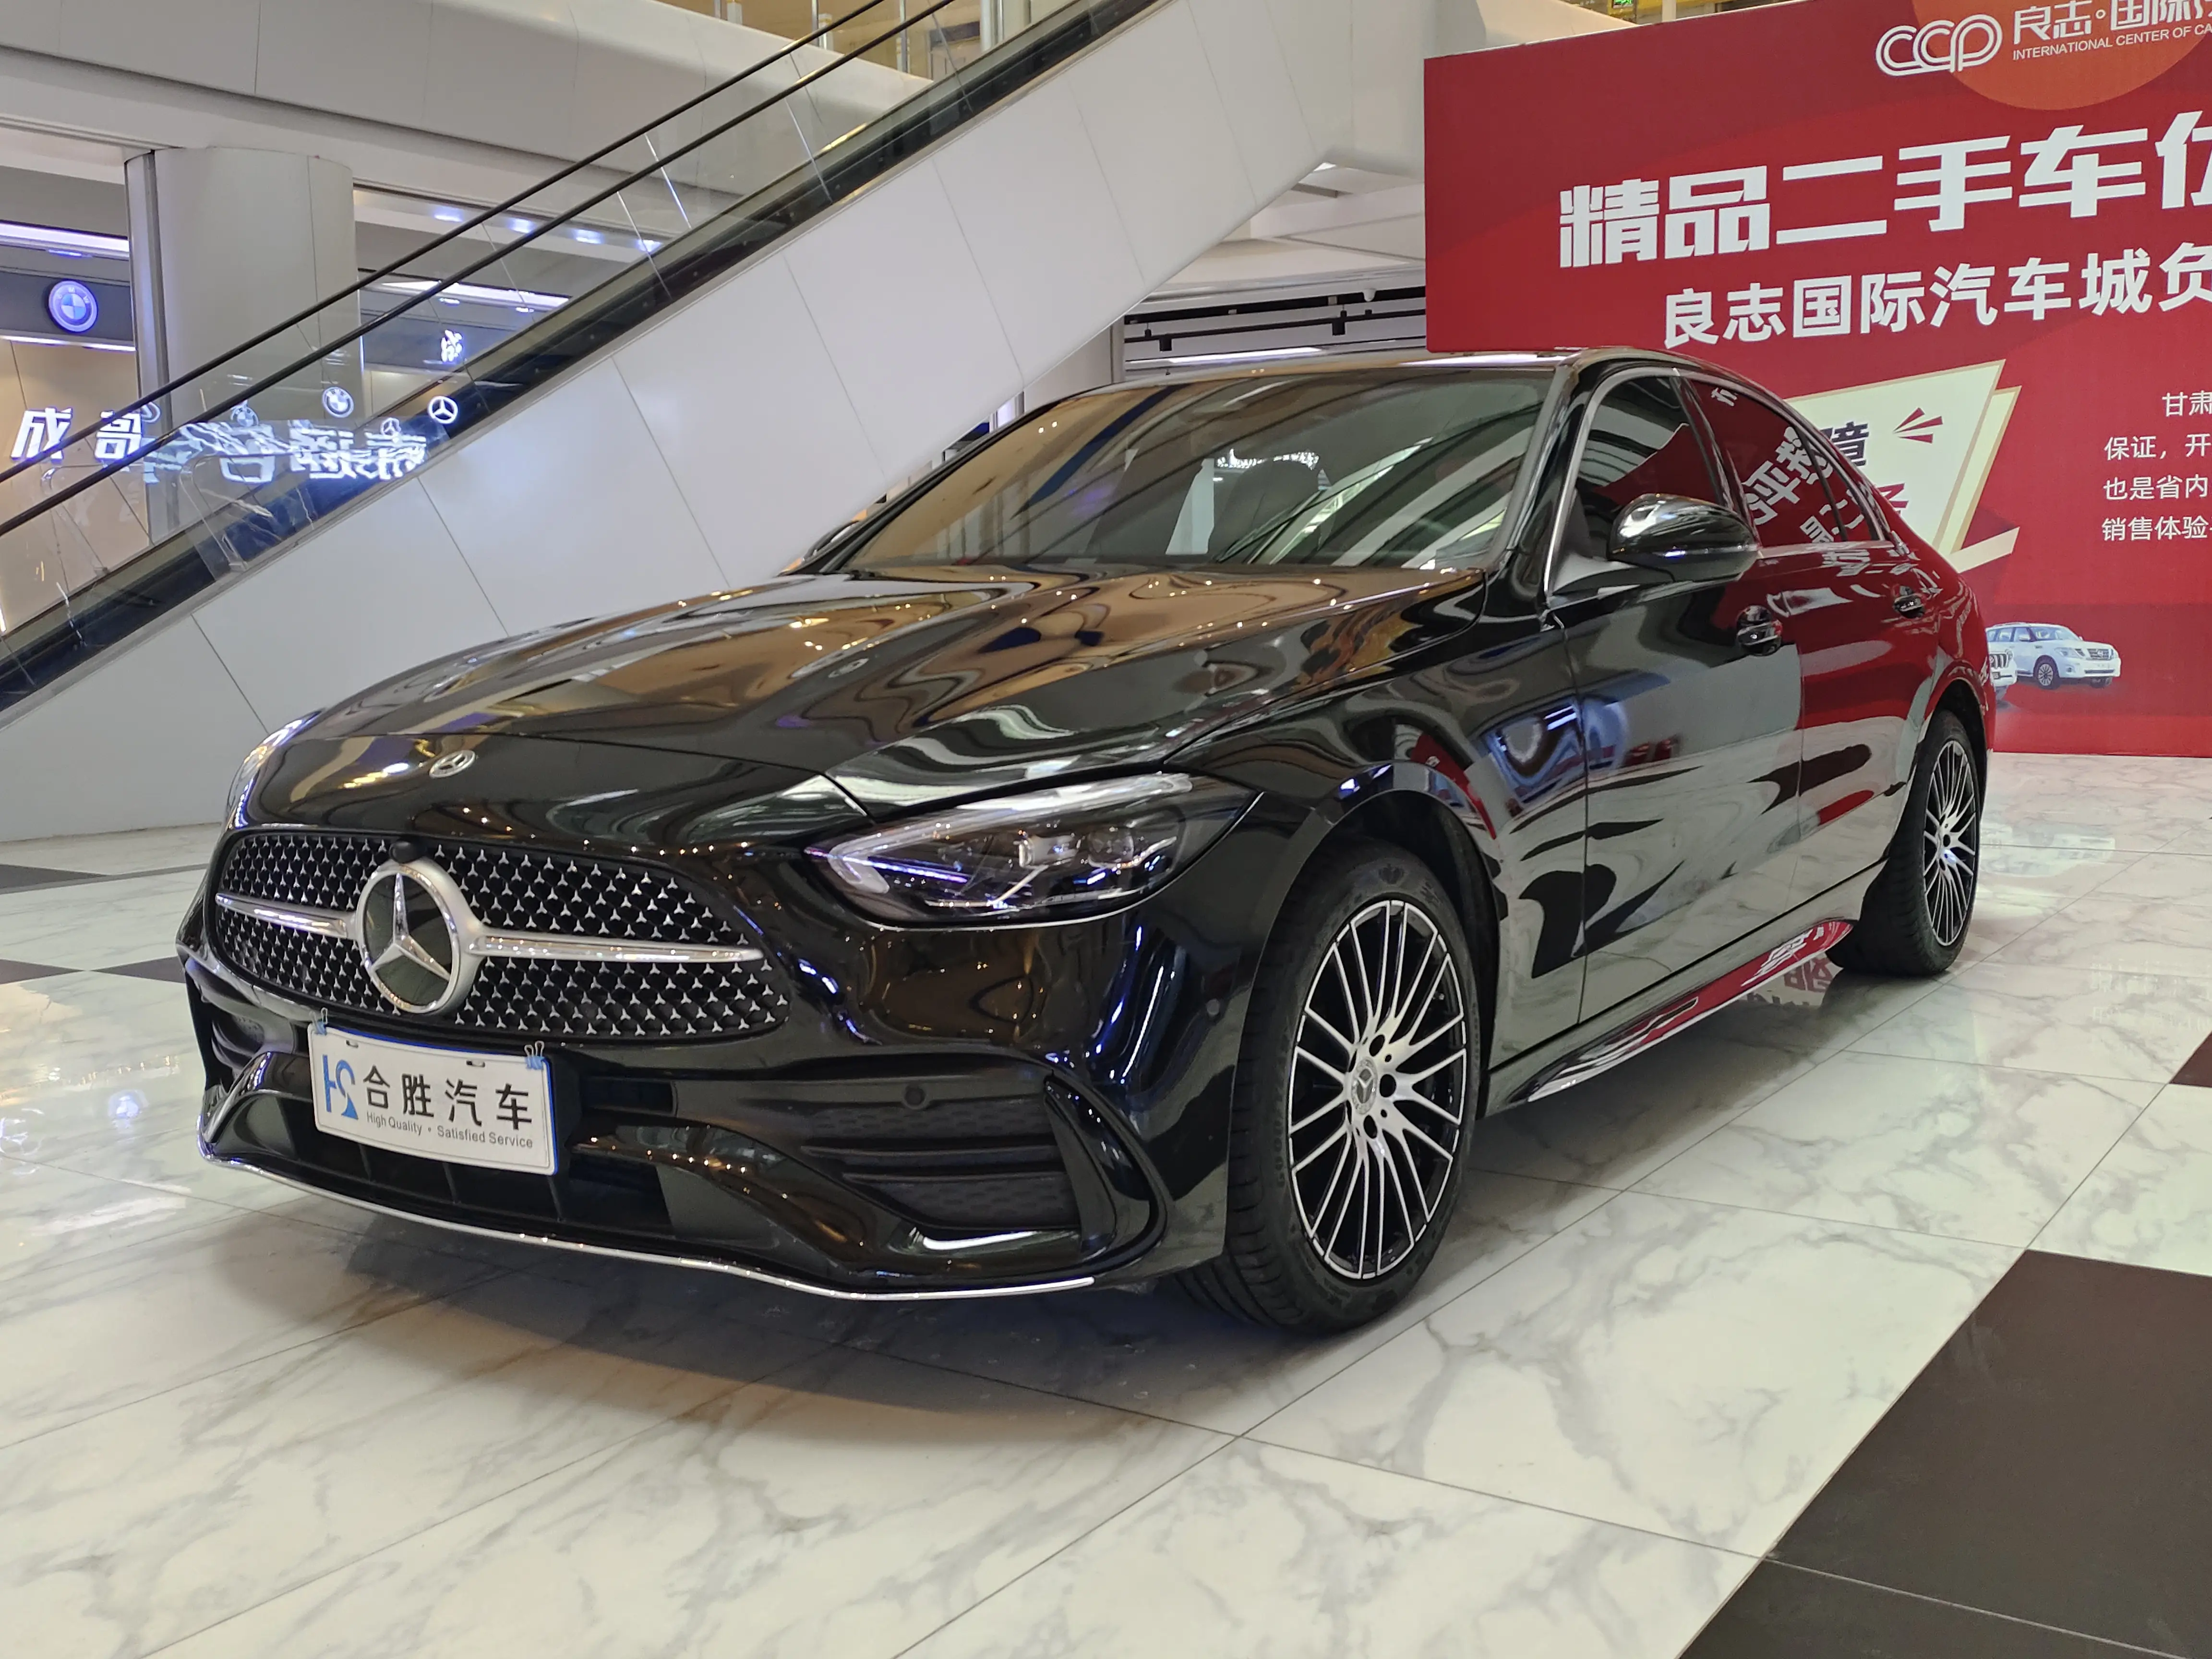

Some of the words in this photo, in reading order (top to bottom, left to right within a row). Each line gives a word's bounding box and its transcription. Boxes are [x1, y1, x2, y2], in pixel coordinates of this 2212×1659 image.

[2013, 36, 2113, 60] INTERNATIONAL
[2116, 29, 2169, 46] CENTER
[2172, 26, 2192, 38] OF
[1664, 242, 2212, 349] 良志国际汽车城负
[2162, 390, 2212, 417] 甘肃
[2103, 473, 2209, 501] 也是省内
[2102, 516, 2212, 541] 销售体验
[363, 1065, 532, 1130] 合胜汽车
[366, 1111, 386, 1129] High
[388, 1117, 423, 1136] Quality
[437, 1125, 486, 1143] Satisfied
[488, 1131, 533, 1149] Service
